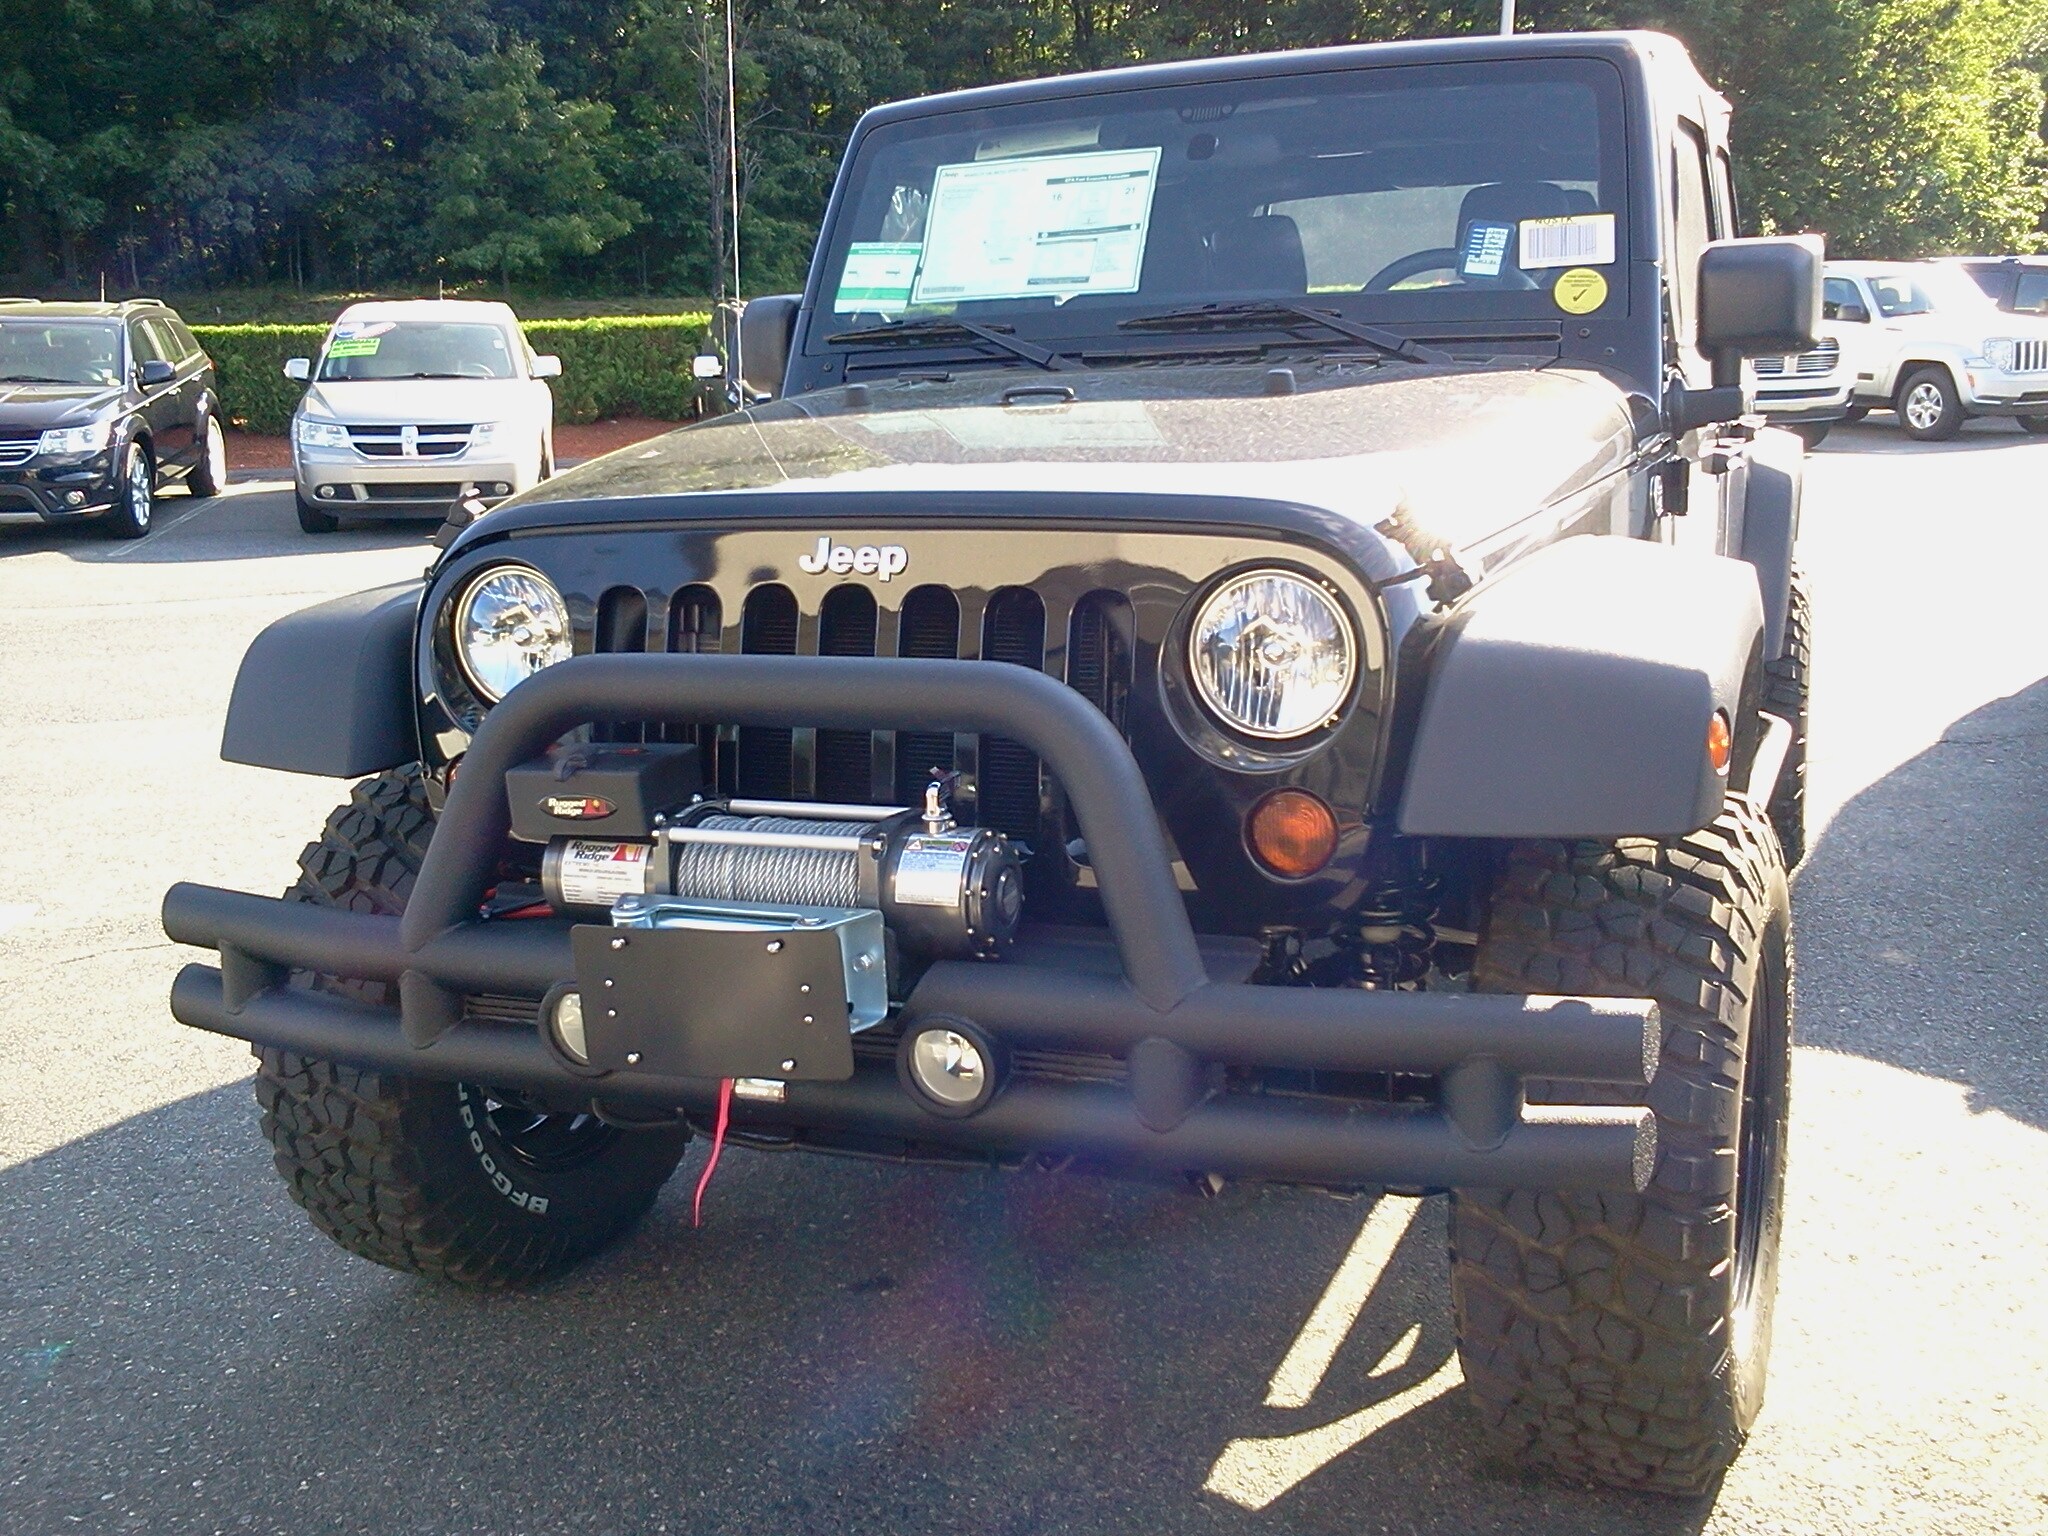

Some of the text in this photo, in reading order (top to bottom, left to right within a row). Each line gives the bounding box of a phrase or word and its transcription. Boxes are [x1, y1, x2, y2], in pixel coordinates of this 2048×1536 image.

[1124, 187, 1136, 196] 21
[1053, 193, 1063, 202] 16
[799, 537, 908, 582] Jeep
[548, 797, 587, 808] Rugged
[553, 806, 582, 817] Ridge
[571, 841, 619, 852] Rugged
[574, 850, 610, 861] Ridge
